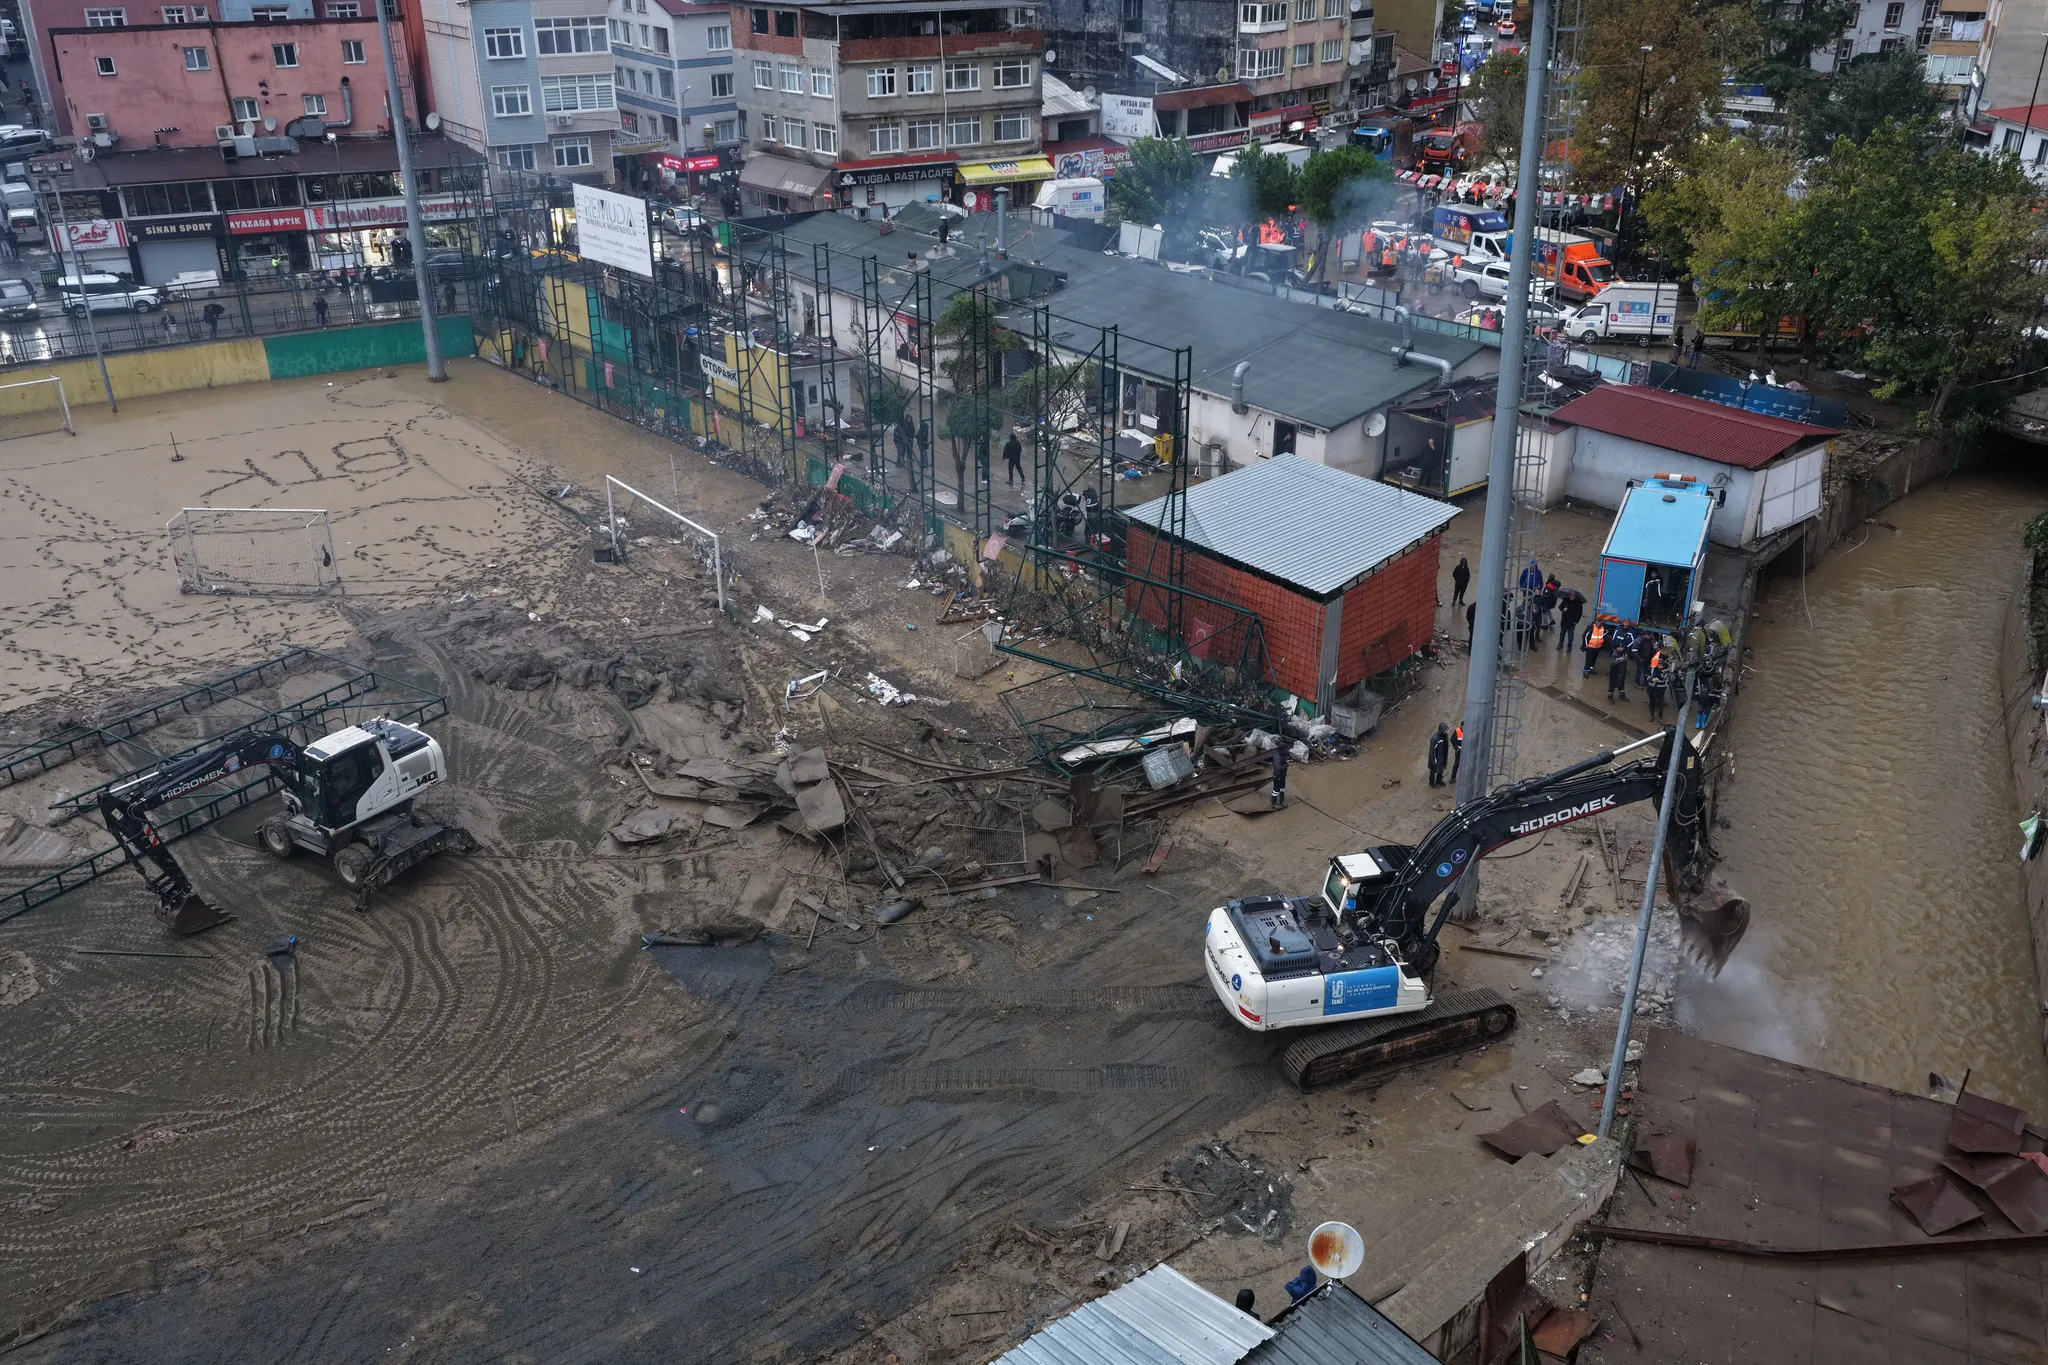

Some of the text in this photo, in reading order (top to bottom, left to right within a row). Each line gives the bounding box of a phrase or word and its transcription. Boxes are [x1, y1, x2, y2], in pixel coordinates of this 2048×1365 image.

[584, 195, 636, 228] REMUDA
[145, 222, 212, 235] SİNAN SPORT
[230, 216, 301, 229] AYAZAĞA OPTİK
[702, 358, 738, 382] OTOPARK
[415, 771, 438, 787] 140
